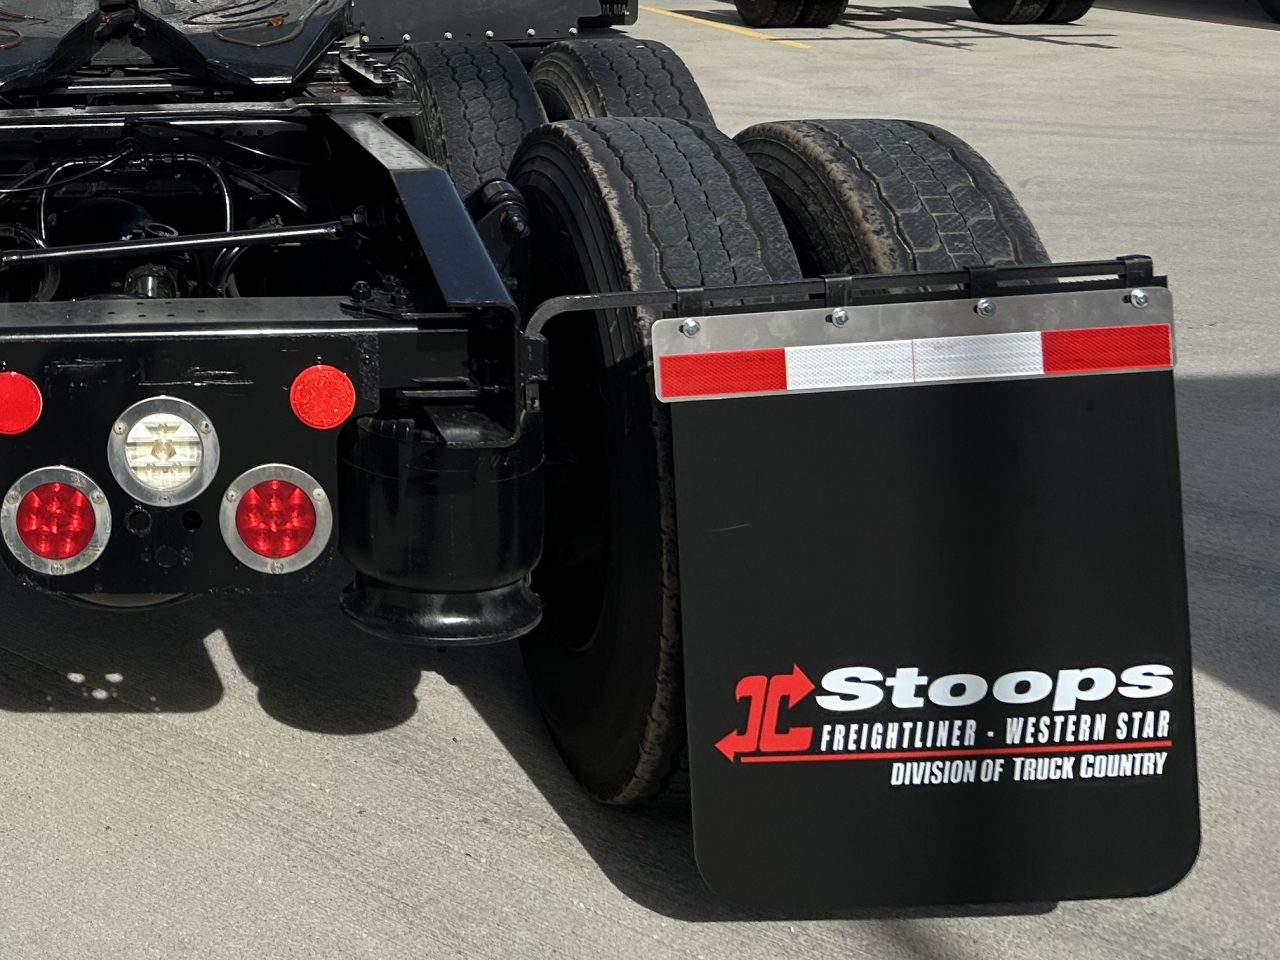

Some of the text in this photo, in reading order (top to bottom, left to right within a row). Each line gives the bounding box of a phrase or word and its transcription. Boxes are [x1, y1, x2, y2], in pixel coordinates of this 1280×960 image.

[816, 665, 1174, 712] Stoops
[820, 720, 977, 751] FREIGHTLINER
[1006, 714, 1106, 744] WESTERN
[1116, 710, 1170, 739] STAR
[891, 752, 1168, 785] DIVISION OF TRUCK COUNTRY
